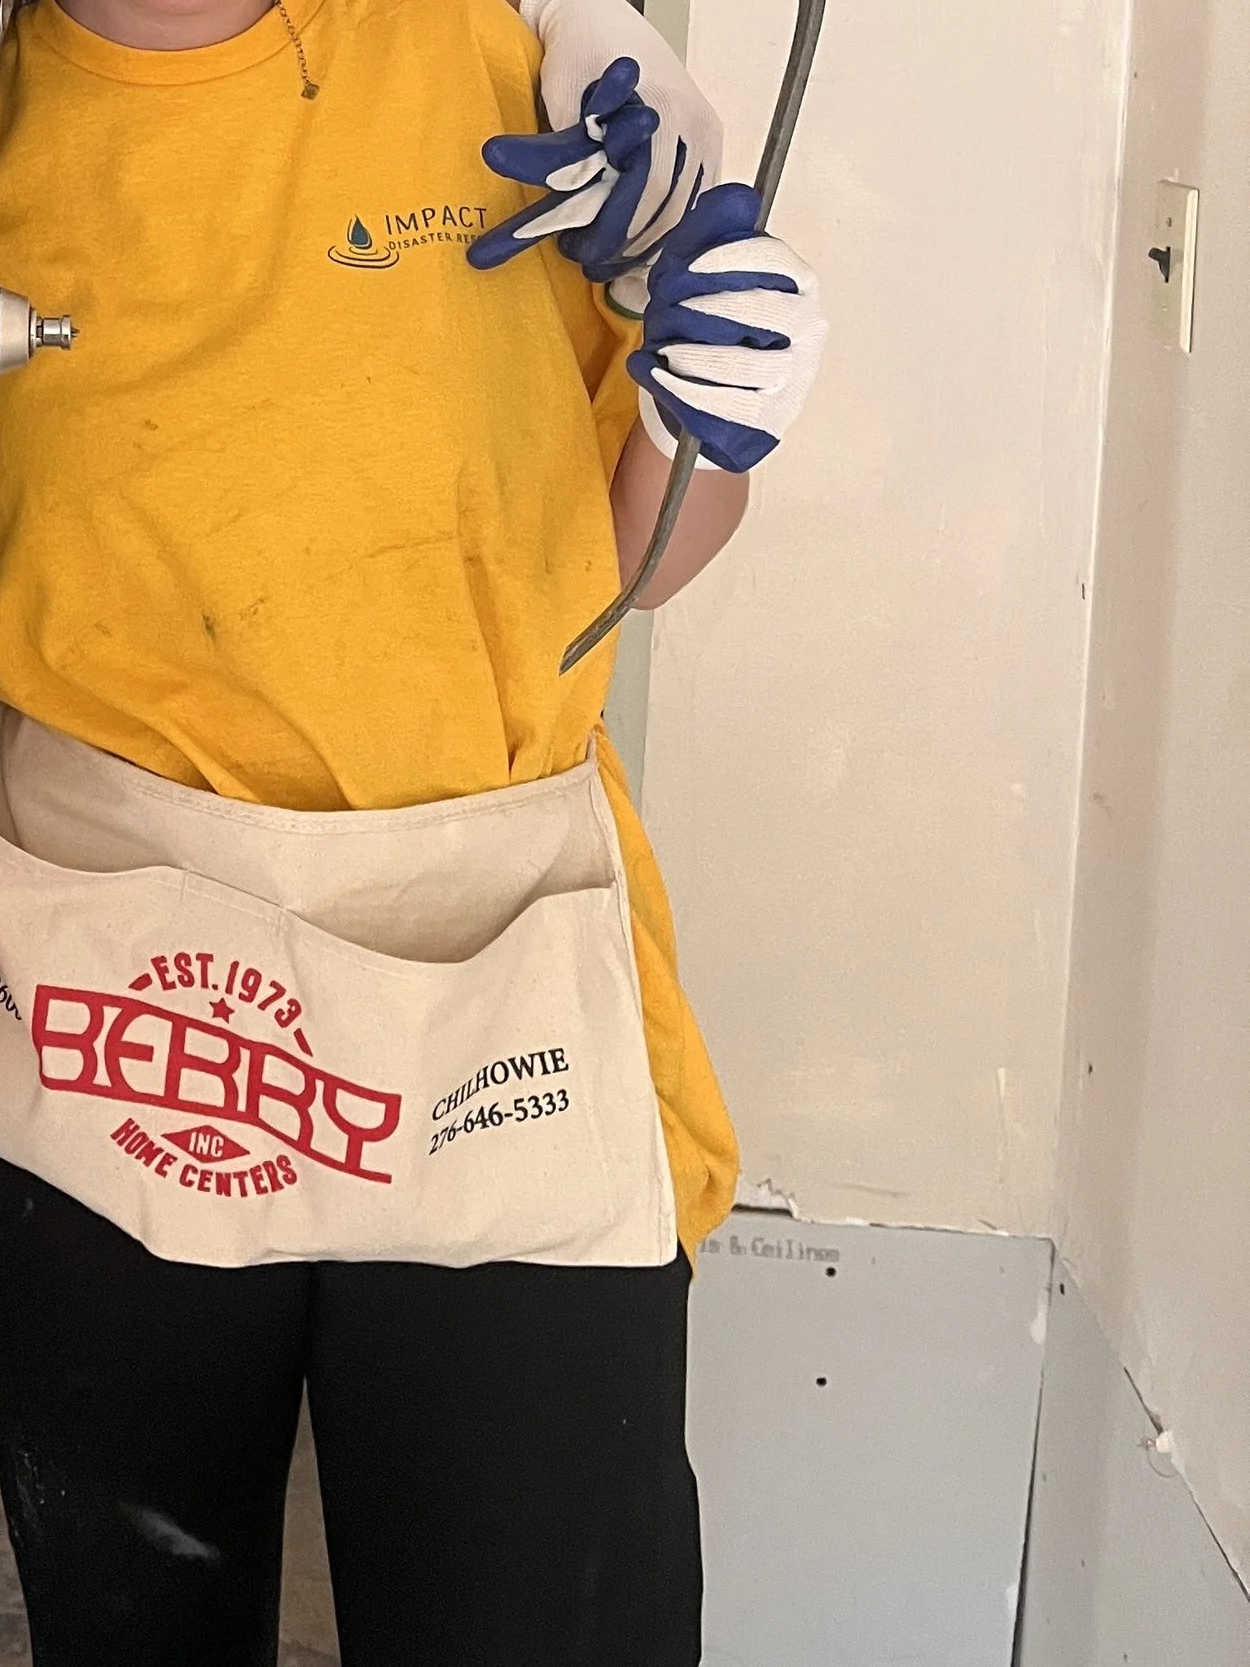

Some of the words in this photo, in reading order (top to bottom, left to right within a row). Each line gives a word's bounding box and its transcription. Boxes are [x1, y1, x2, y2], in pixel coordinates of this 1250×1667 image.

[385, 205, 487, 235] IMPACT
[388, 232, 452, 250] DISASTER
[431, 1047, 570, 1122] CHILHOWIE
[188, 1132, 226, 1158] INC
[428, 1088, 570, 1157] 276-646-5333
[109, 1117, 178, 1179] HOME
[178, 1153, 299, 1199] CENTERS
